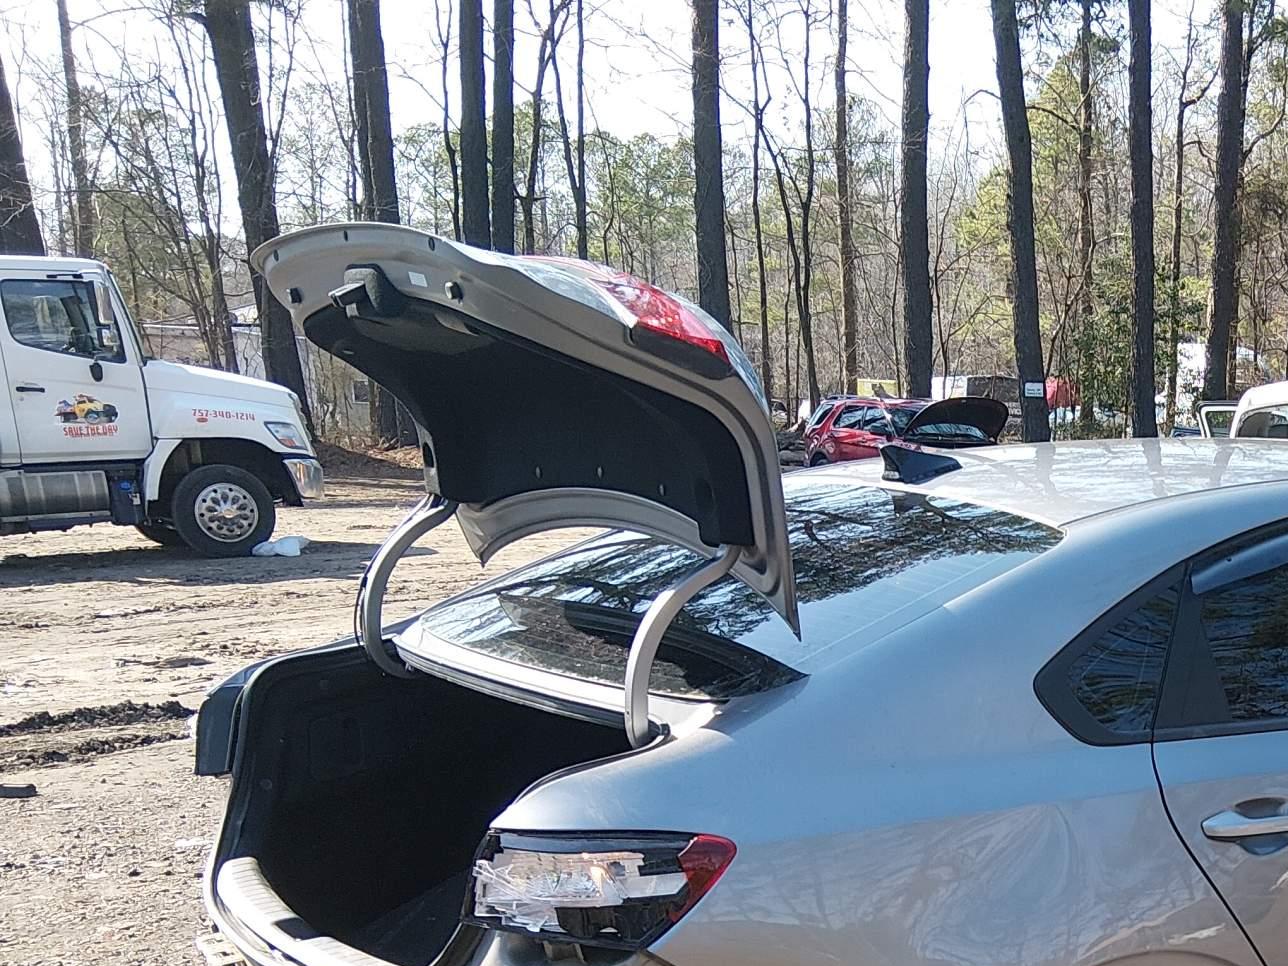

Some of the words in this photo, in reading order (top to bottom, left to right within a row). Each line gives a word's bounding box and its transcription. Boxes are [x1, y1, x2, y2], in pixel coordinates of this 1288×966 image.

[192, 408, 255, 421] 757-340-1214
[63, 426, 83, 437] SAVE
[84, 425, 101, 436] THE
[102, 424, 118, 435] DAY
